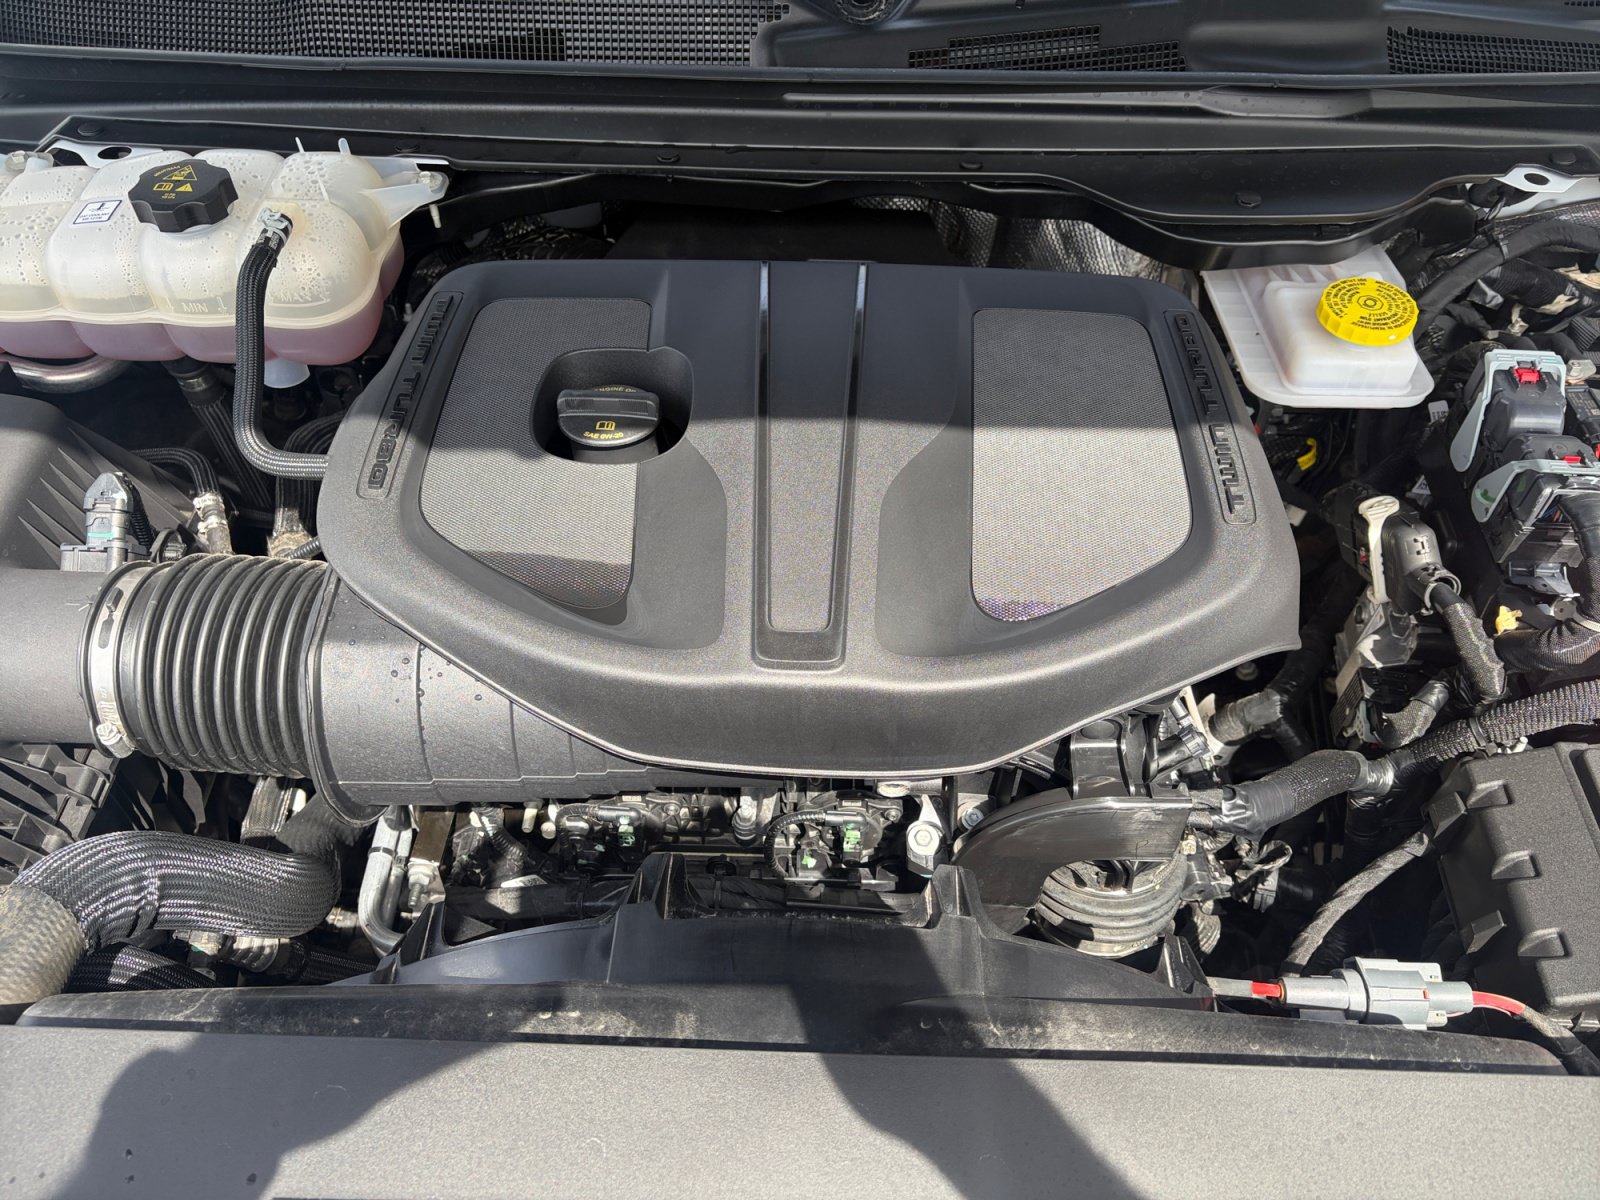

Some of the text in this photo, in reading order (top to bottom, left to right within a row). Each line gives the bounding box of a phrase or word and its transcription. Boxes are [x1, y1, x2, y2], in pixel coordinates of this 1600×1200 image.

[183, 302, 208, 312] MIN
[367, 294, 454, 490] TWIN TURBO
[583, 431, 599, 439] SAE
[1174, 313, 1245, 515] TWIN TURBO
